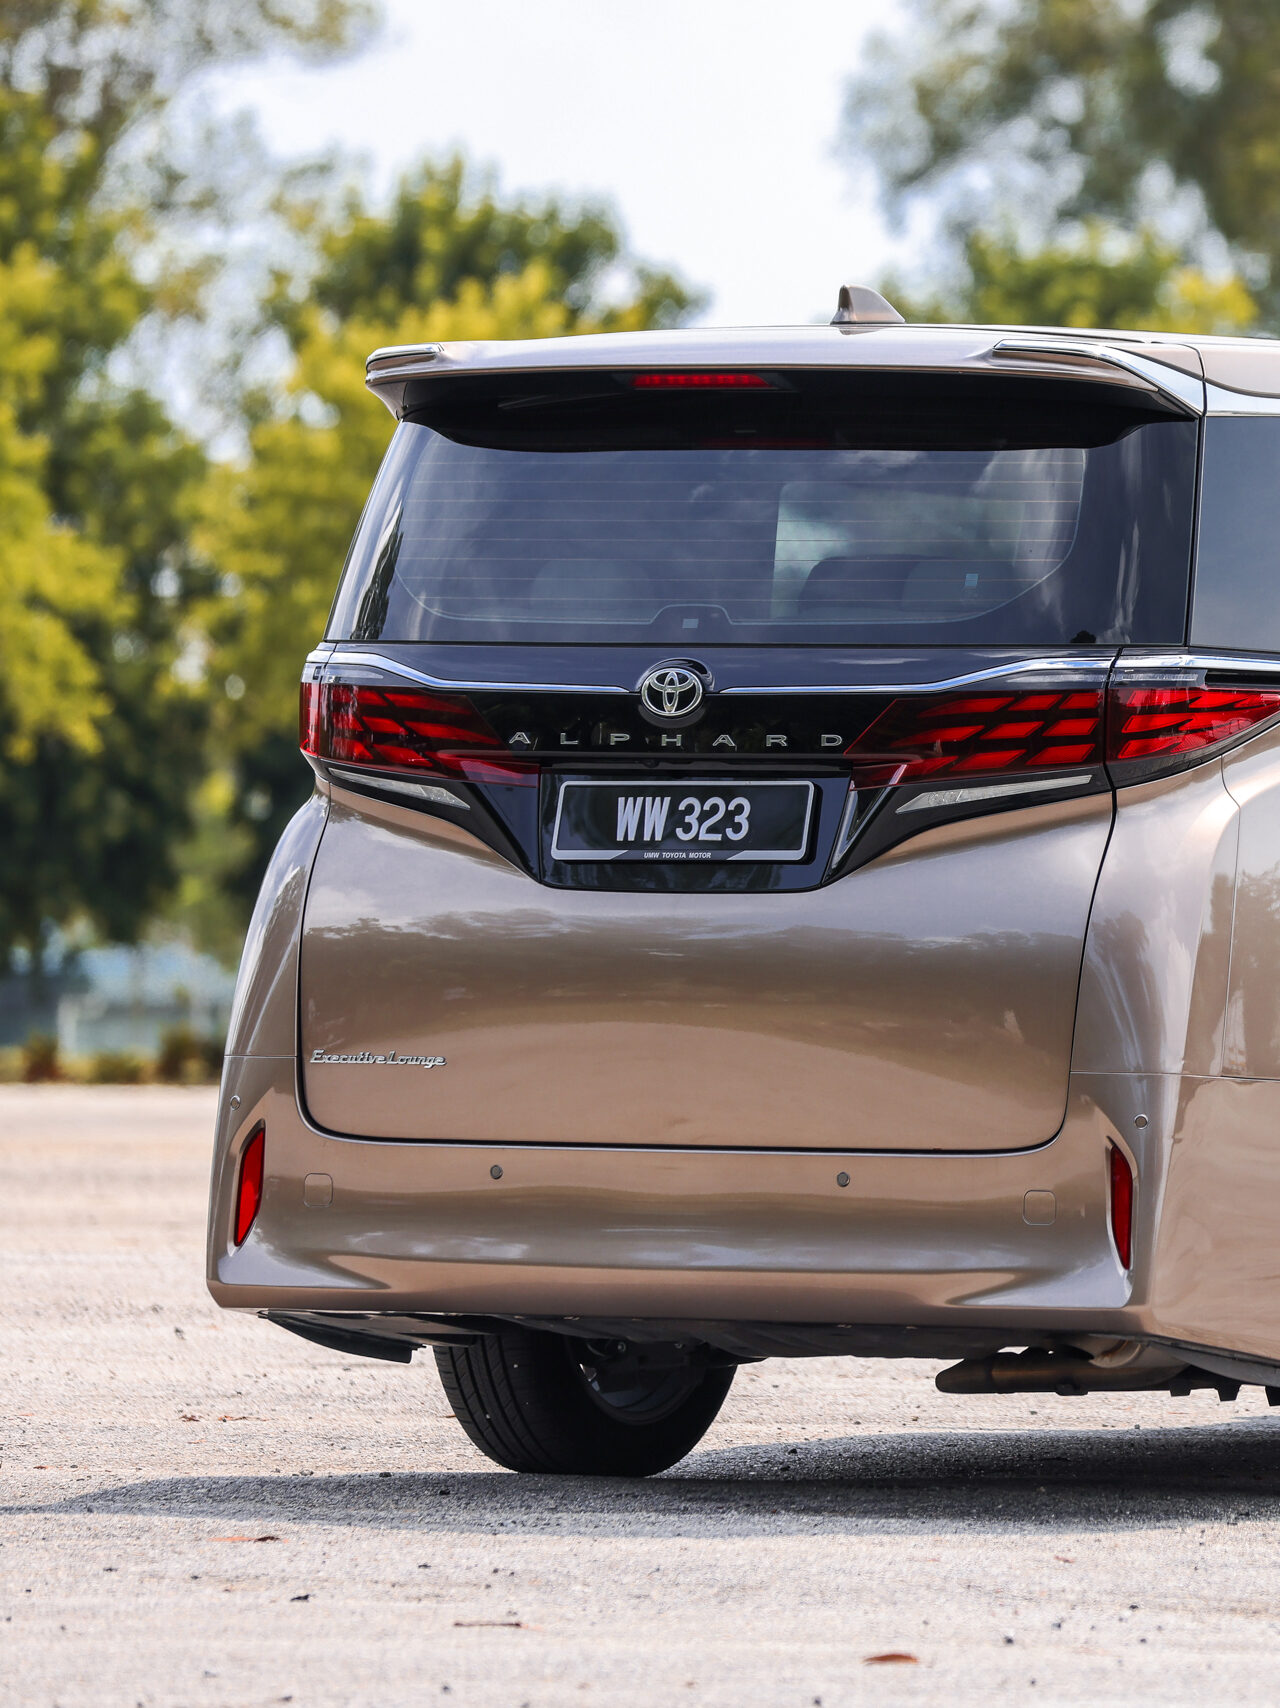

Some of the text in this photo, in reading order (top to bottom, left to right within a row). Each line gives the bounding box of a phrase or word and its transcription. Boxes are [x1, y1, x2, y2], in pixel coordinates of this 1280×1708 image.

[509, 731, 843, 747] ALPHARD
[616, 796, 751, 842] WW 323
[310, 1049, 447, 1069] Executive Lounge
